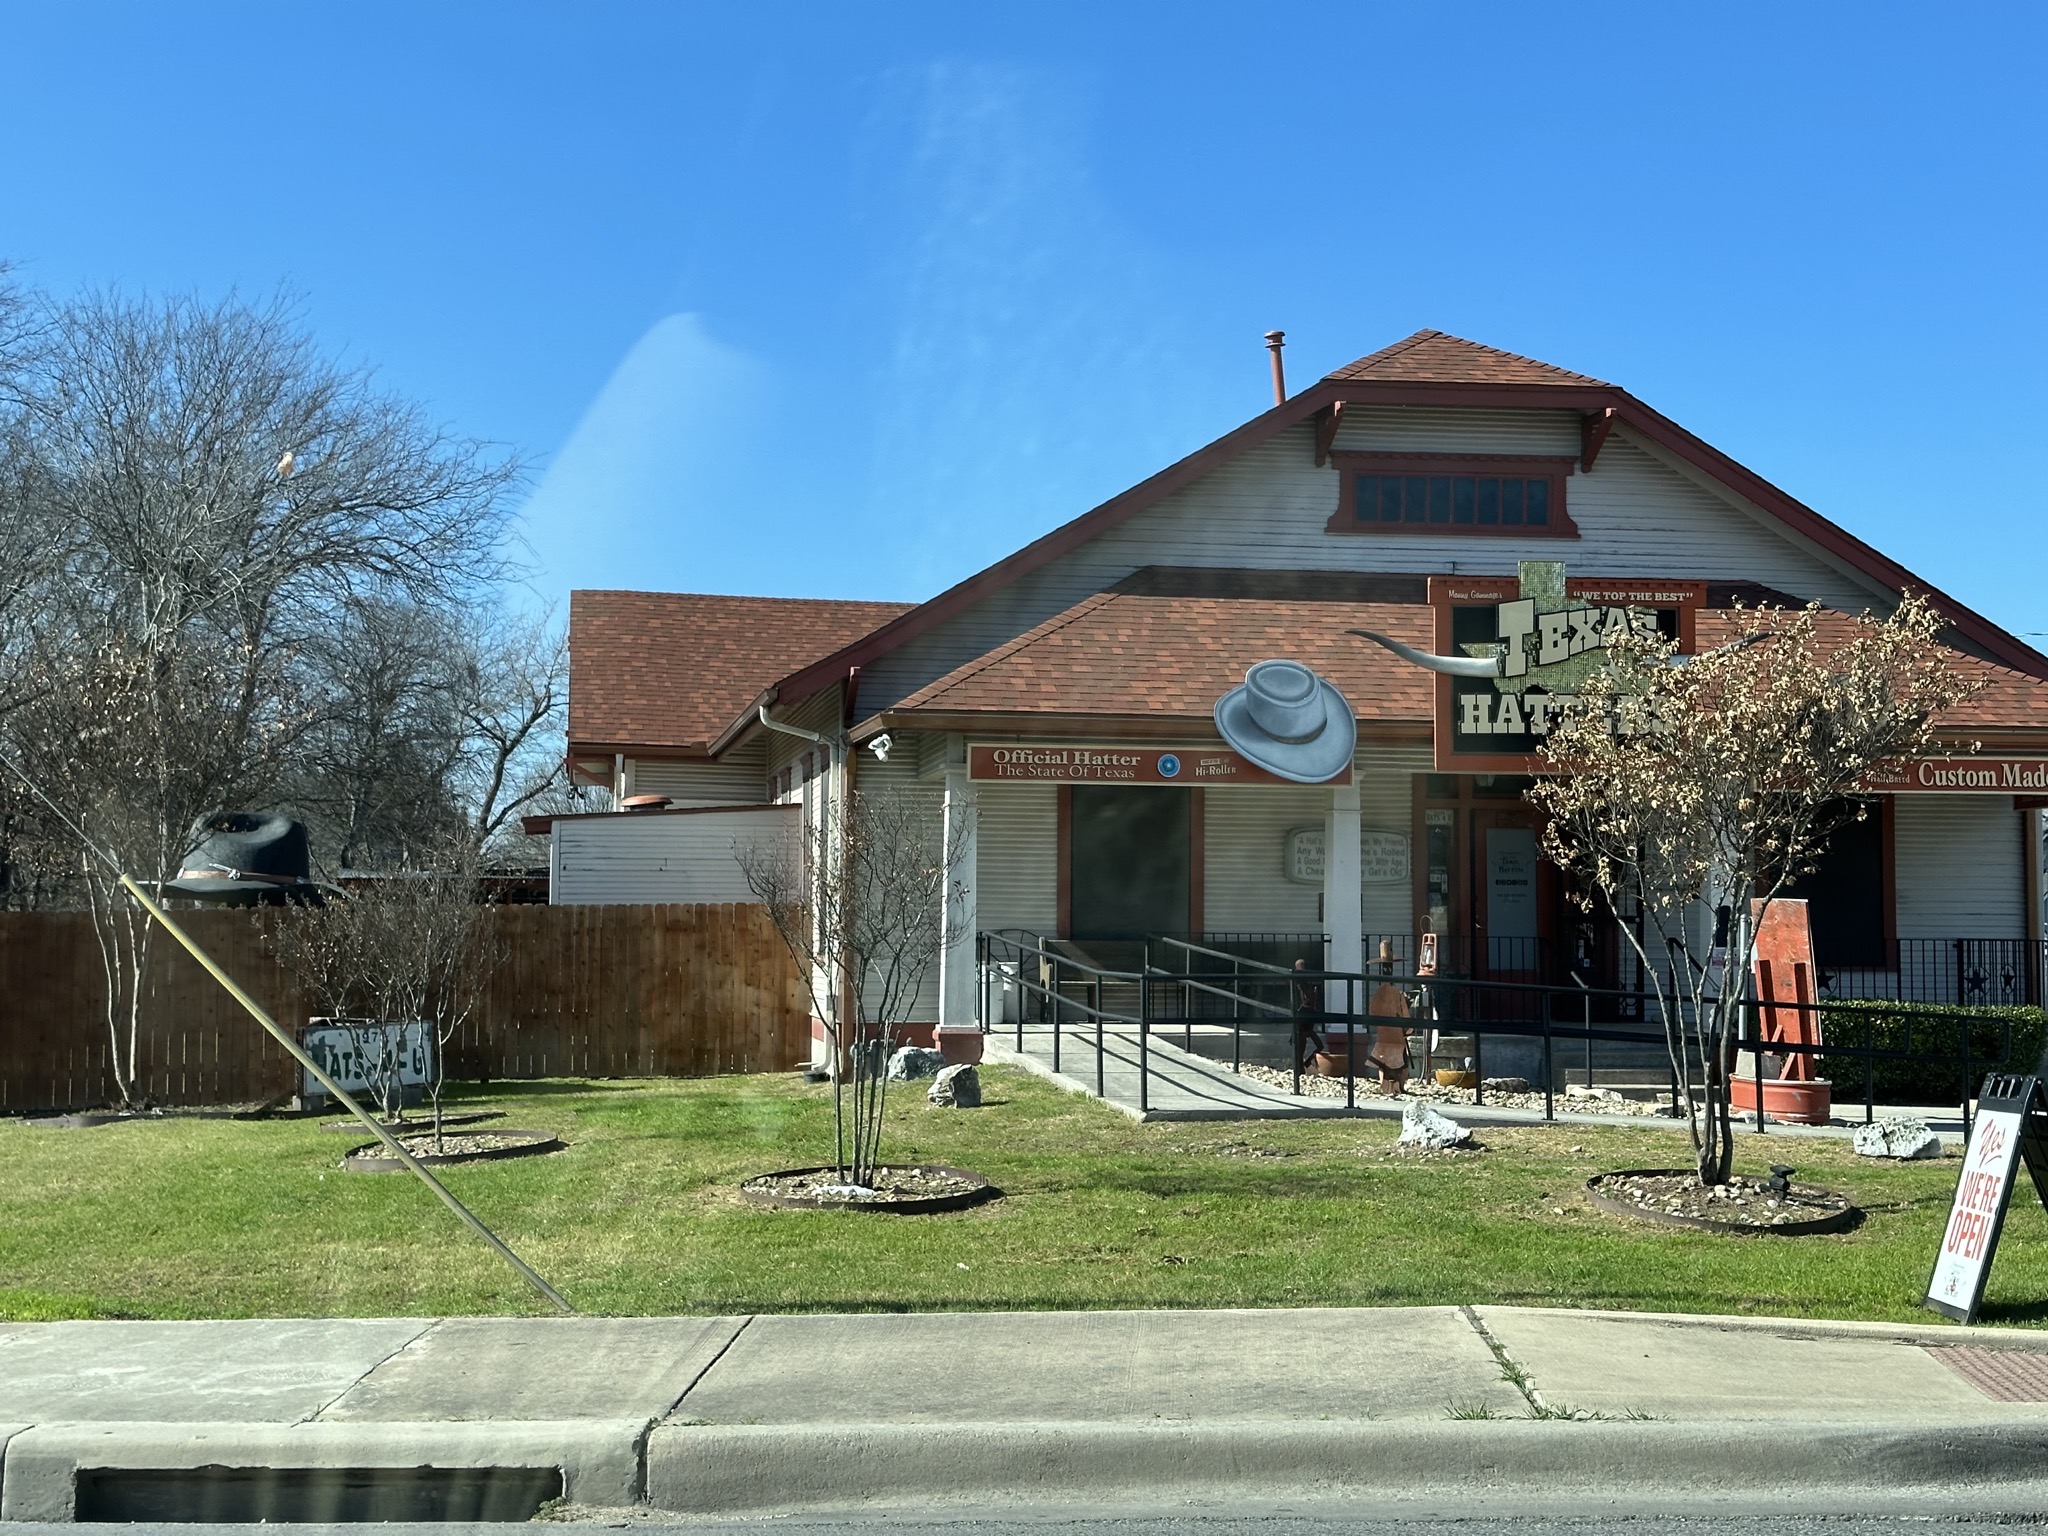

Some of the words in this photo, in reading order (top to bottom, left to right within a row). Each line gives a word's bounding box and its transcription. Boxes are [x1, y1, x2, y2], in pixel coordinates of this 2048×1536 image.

[1602, 591, 1626, 601] TOP
[1628, 592, 1653, 601] THE
[1499, 598, 1659, 678] TEXAS
[1459, 693, 1678, 735] HATTE
[993, 749, 1068, 765] Official
[1073, 751, 1142, 767] Hatter
[994, 763, 1024, 777] The
[1028, 764, 1065, 777] State
[1069, 765, 1090, 778] Of
[1093, 765, 1135, 779] Texas
[1918, 762, 1998, 788] Custom
[2001, 763, 2048, 788] Mad
[1297, 846, 1311, 857] Any
[1361, 847, 1378, 857] he's
[1381, 847, 1405, 857] Rolled
[1304, 856, 1321, 866] Good
[1305, 866, 1325, 876] Chea
[1959, 1170, 2001, 1214] WE'RE
[1947, 1208, 1990, 1261] OPEN
